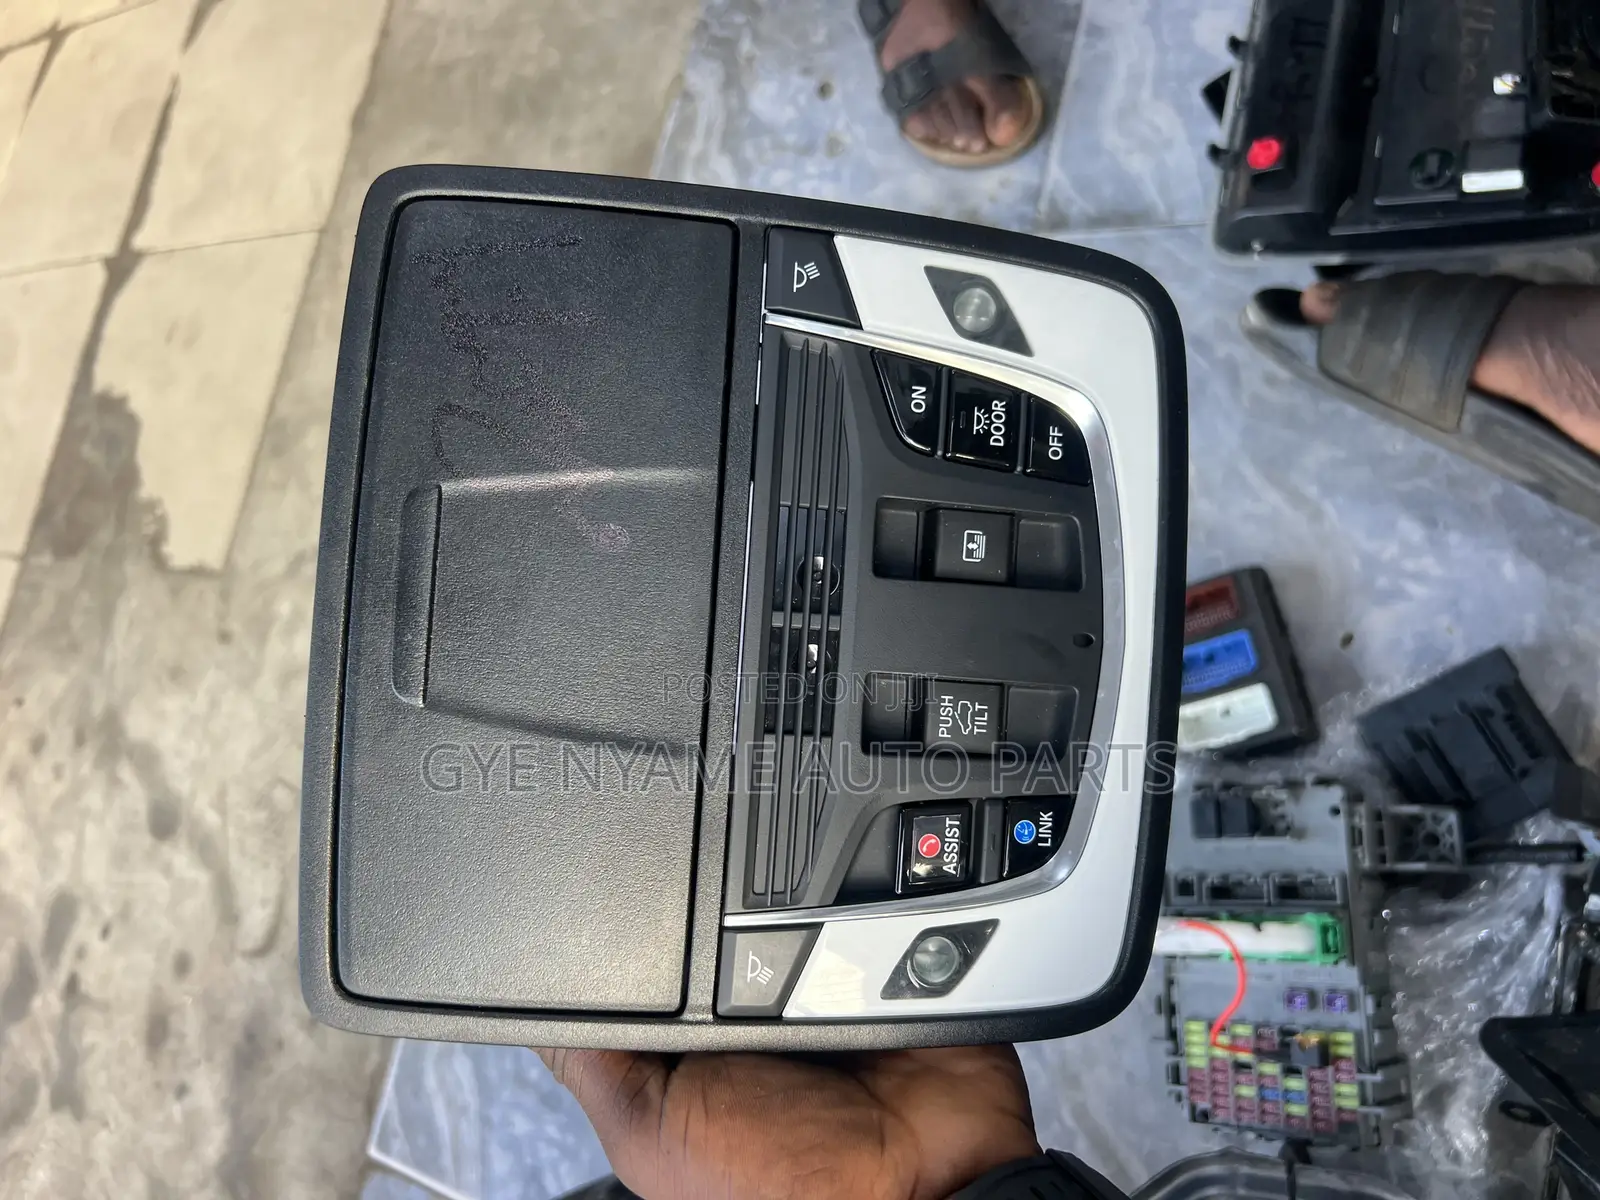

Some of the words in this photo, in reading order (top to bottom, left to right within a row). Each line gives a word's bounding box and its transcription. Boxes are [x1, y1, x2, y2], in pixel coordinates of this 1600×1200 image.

[911, 386, 926, 413] ON
[990, 400, 1006, 447] DOOR
[1049, 426, 1063, 460] OFF
[939, 695, 954, 738] PUSH
[974, 702, 989, 735] TILT
[943, 817, 961, 875] ASSIST
[1038, 811, 1053, 847] LINK
